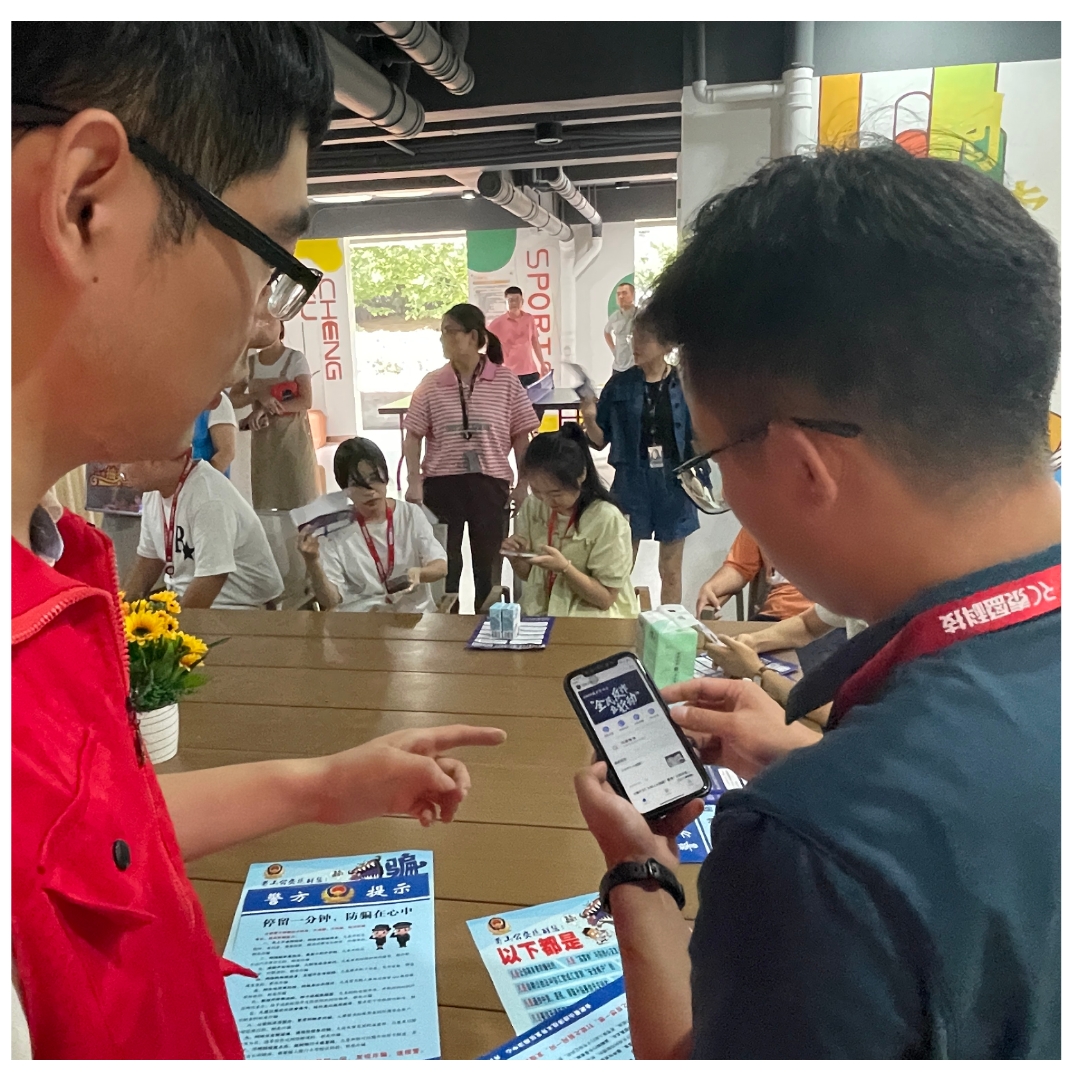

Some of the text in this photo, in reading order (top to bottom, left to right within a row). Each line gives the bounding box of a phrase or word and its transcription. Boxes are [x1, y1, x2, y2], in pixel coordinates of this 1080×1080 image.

[319, 277, 343, 381] CHENG
[938, 586, 1031, 634] 泰盈科技
[384, 853, 427, 878] 骗
[263, 883, 412, 906] 警方 提示
[496, 930, 584, 966] 以下都是
